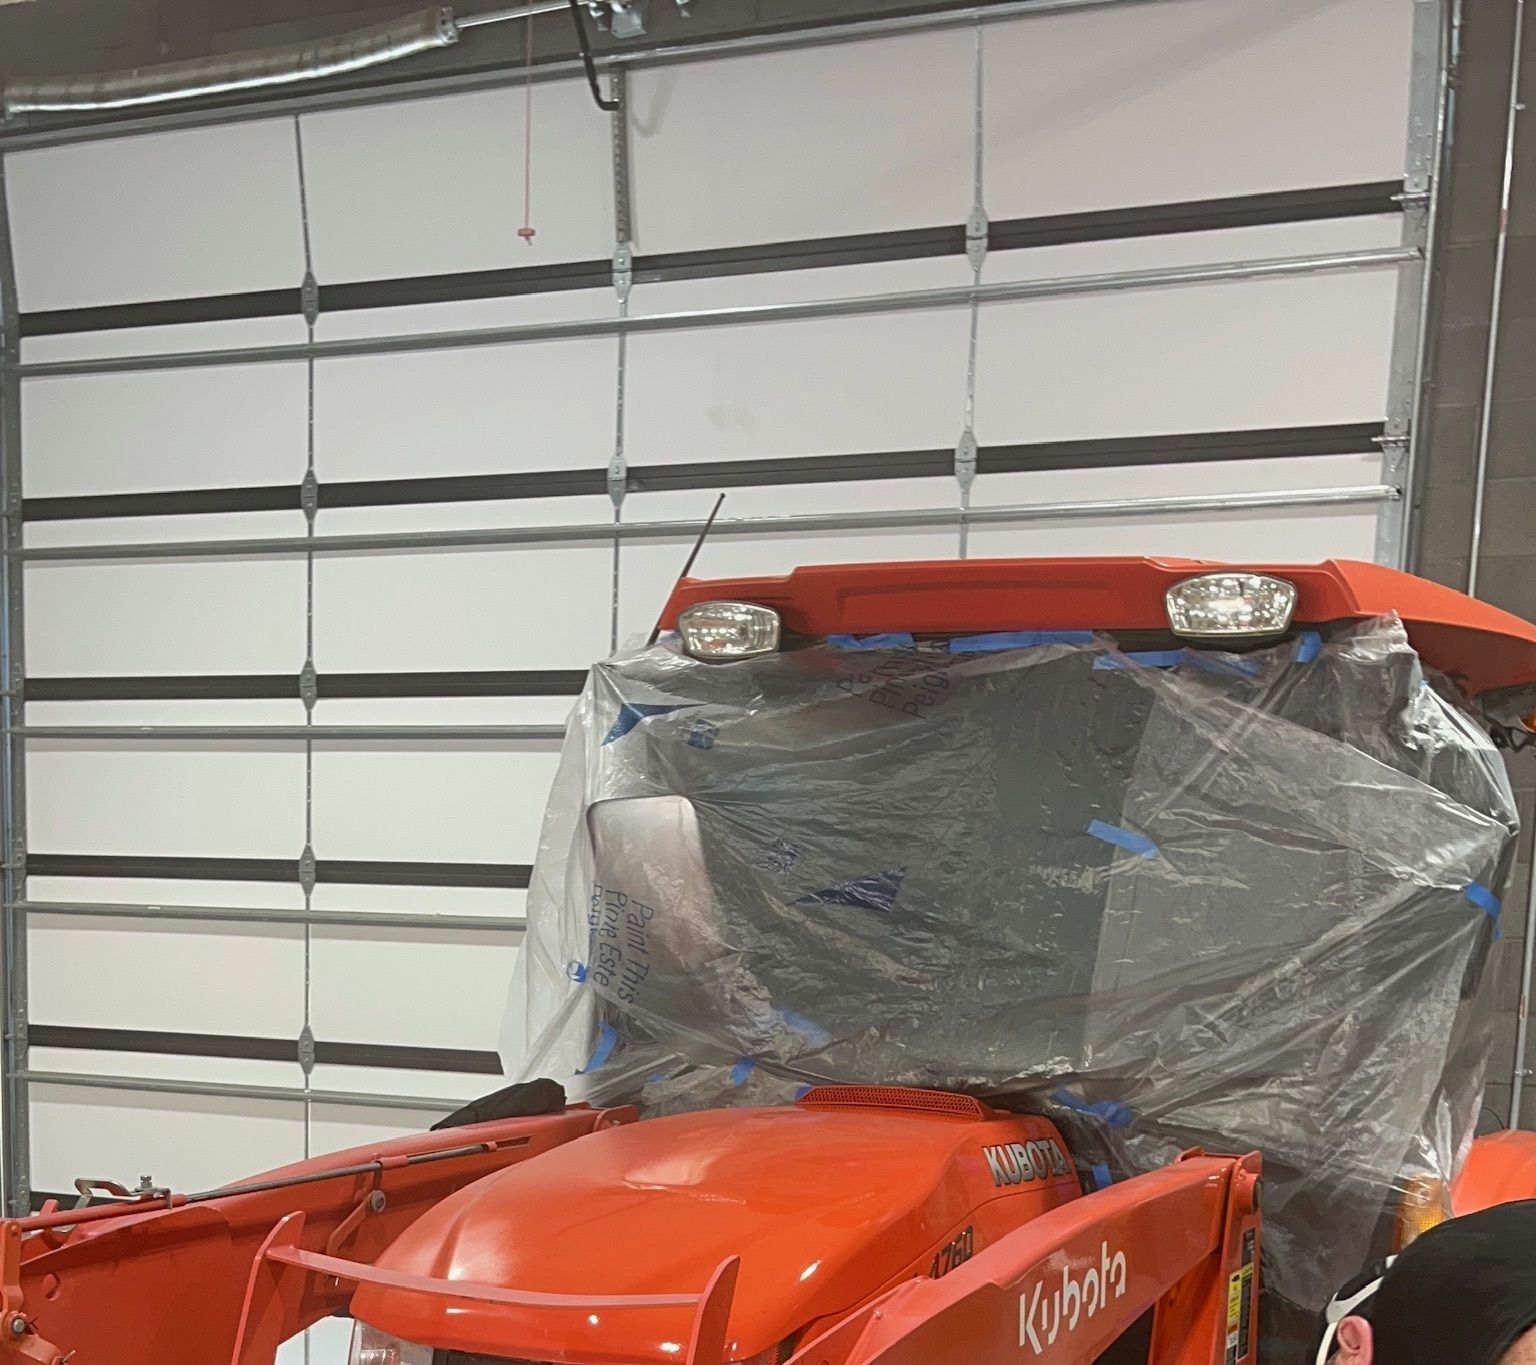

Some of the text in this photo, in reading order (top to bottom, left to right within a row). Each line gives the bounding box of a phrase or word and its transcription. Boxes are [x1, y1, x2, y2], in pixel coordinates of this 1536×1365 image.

[593, 942, 622, 987] Este
[617, 899, 654, 1003] Paint This
[983, 1138, 1071, 1187] KUBOTA
[1018, 1240, 1127, 1356] Kubota
